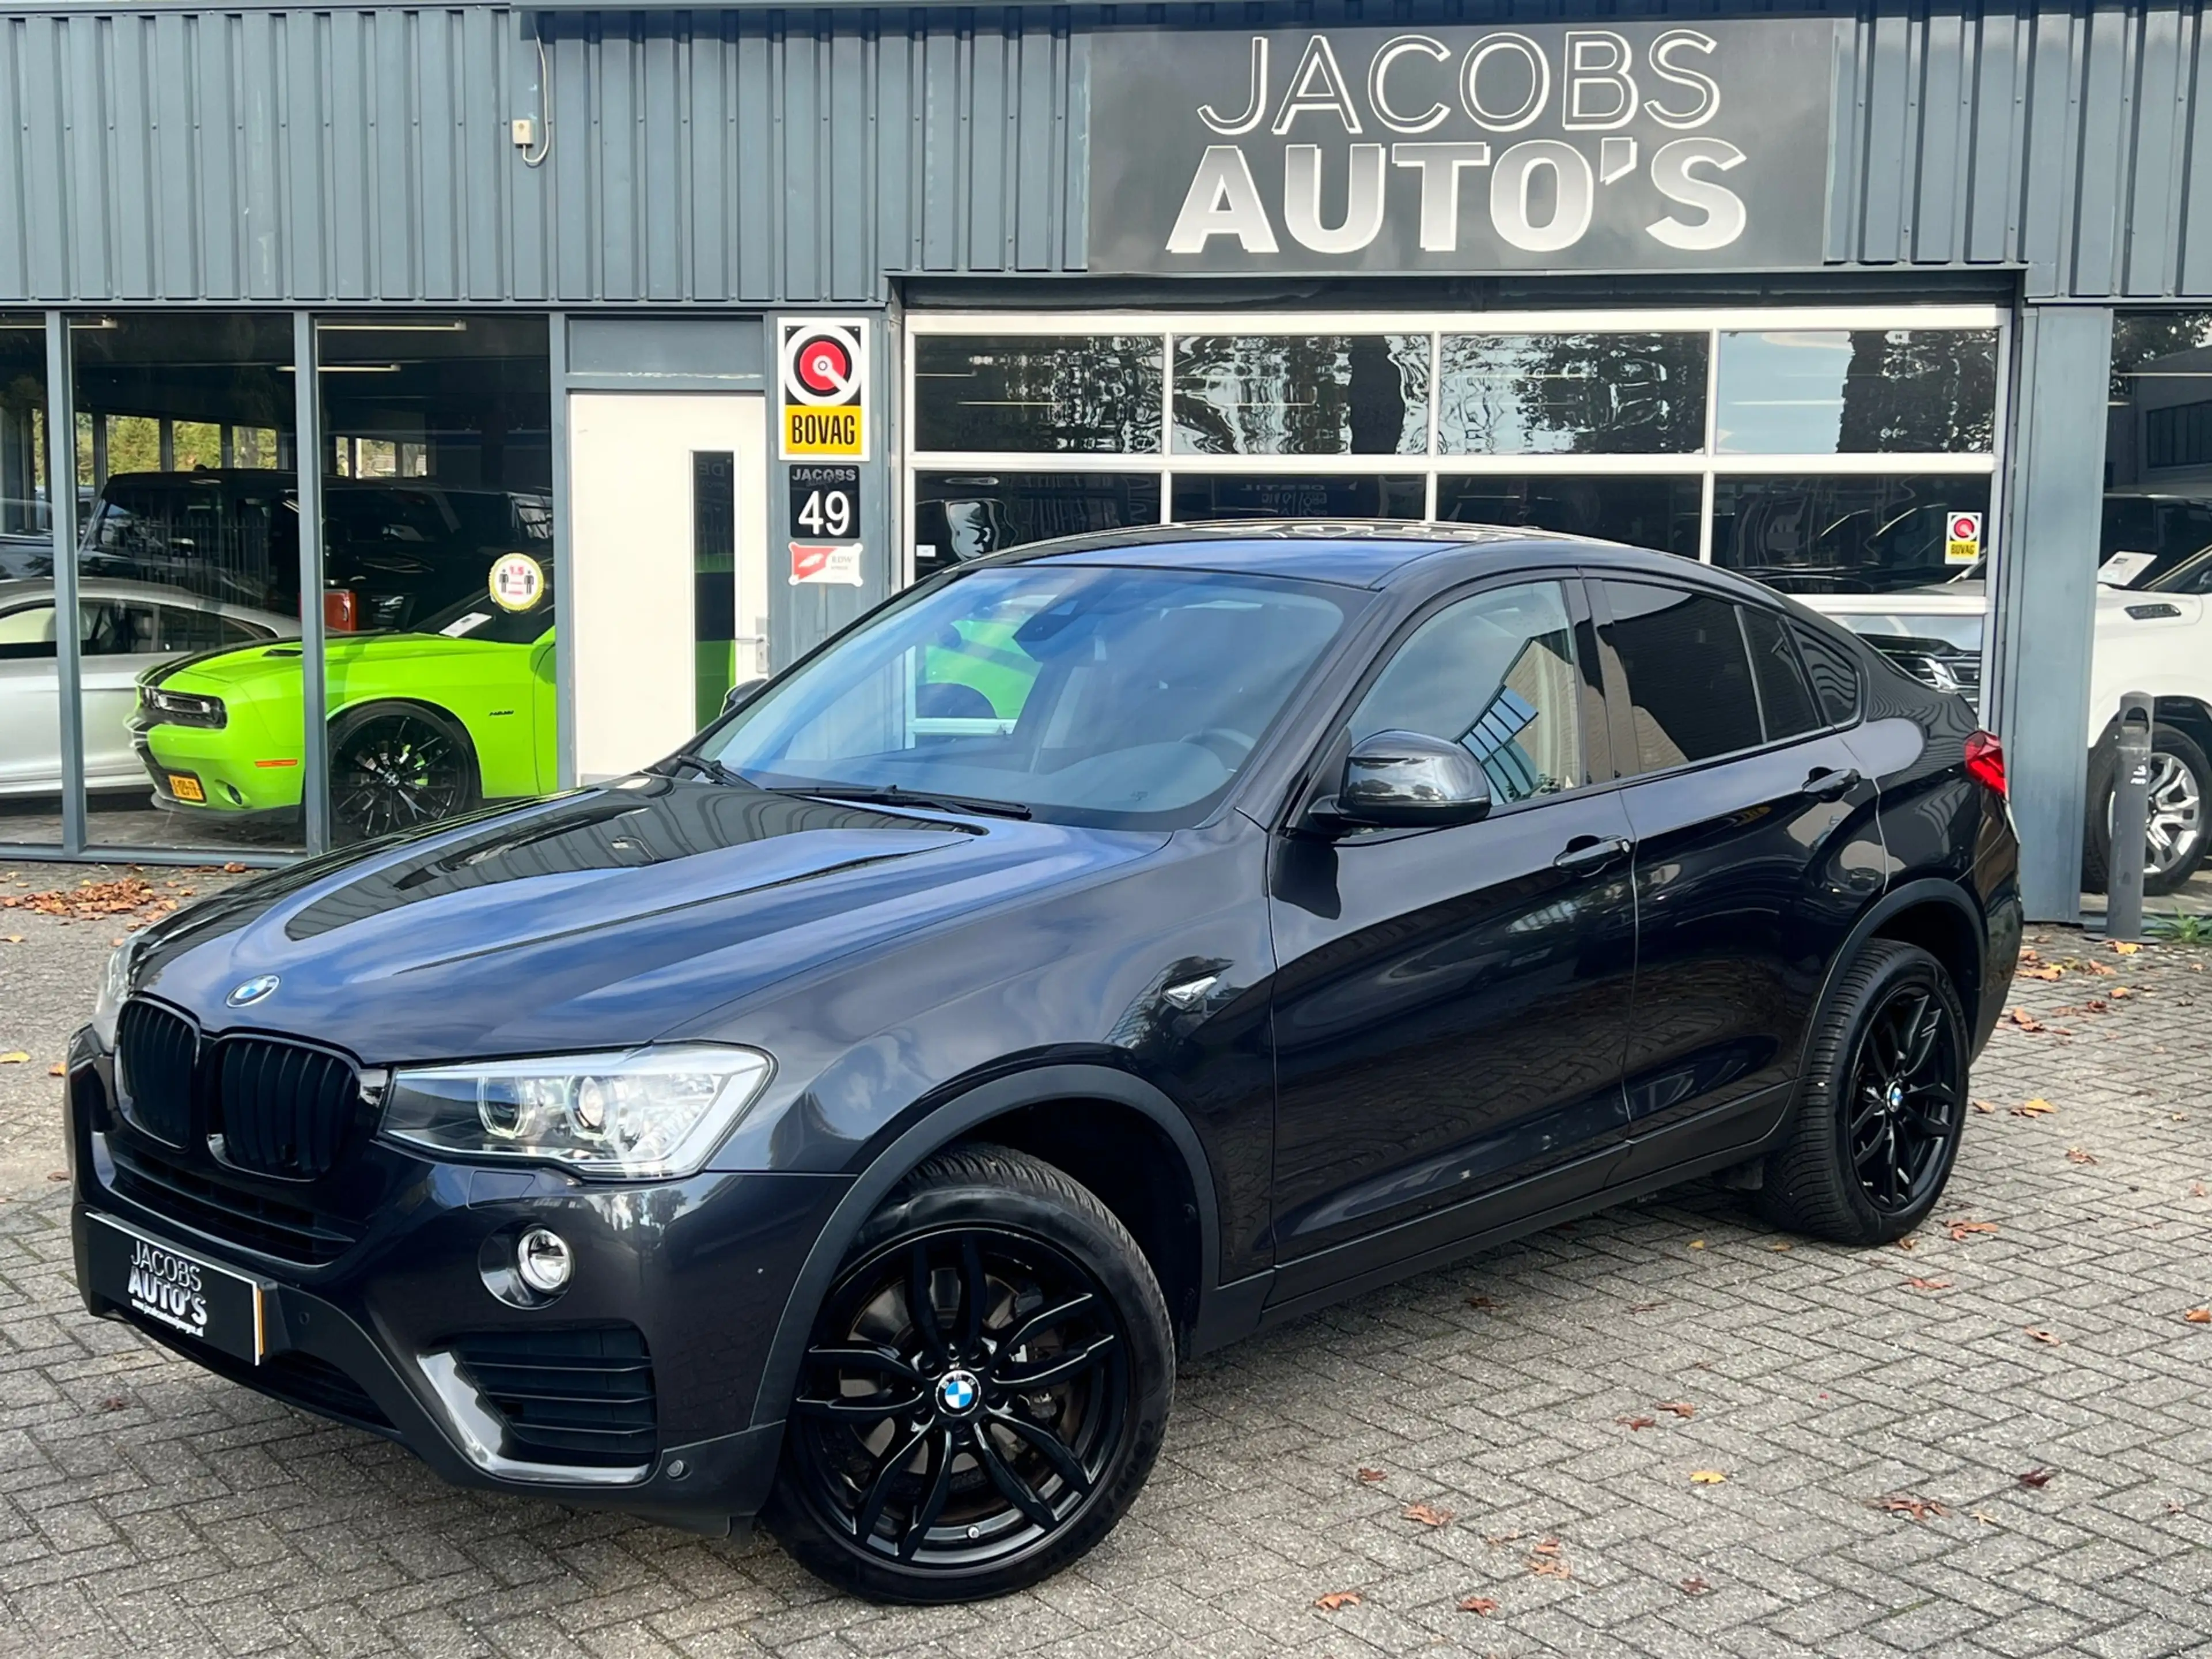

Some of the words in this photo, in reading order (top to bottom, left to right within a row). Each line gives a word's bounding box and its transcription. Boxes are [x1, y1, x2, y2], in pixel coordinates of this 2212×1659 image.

[1196, 29, 1721, 136] JACOBS
[1165, 136, 1748, 253] AUTO'S
[792, 414, 855, 445] BOVAG
[792, 468, 856, 482] JACOBS
[798, 490, 850, 536] 49
[1950, 544, 1975, 555] BOVAG
[130, 1240, 202, 1291] JACOBS
[127, 1266, 207, 1325] AUTO'S
